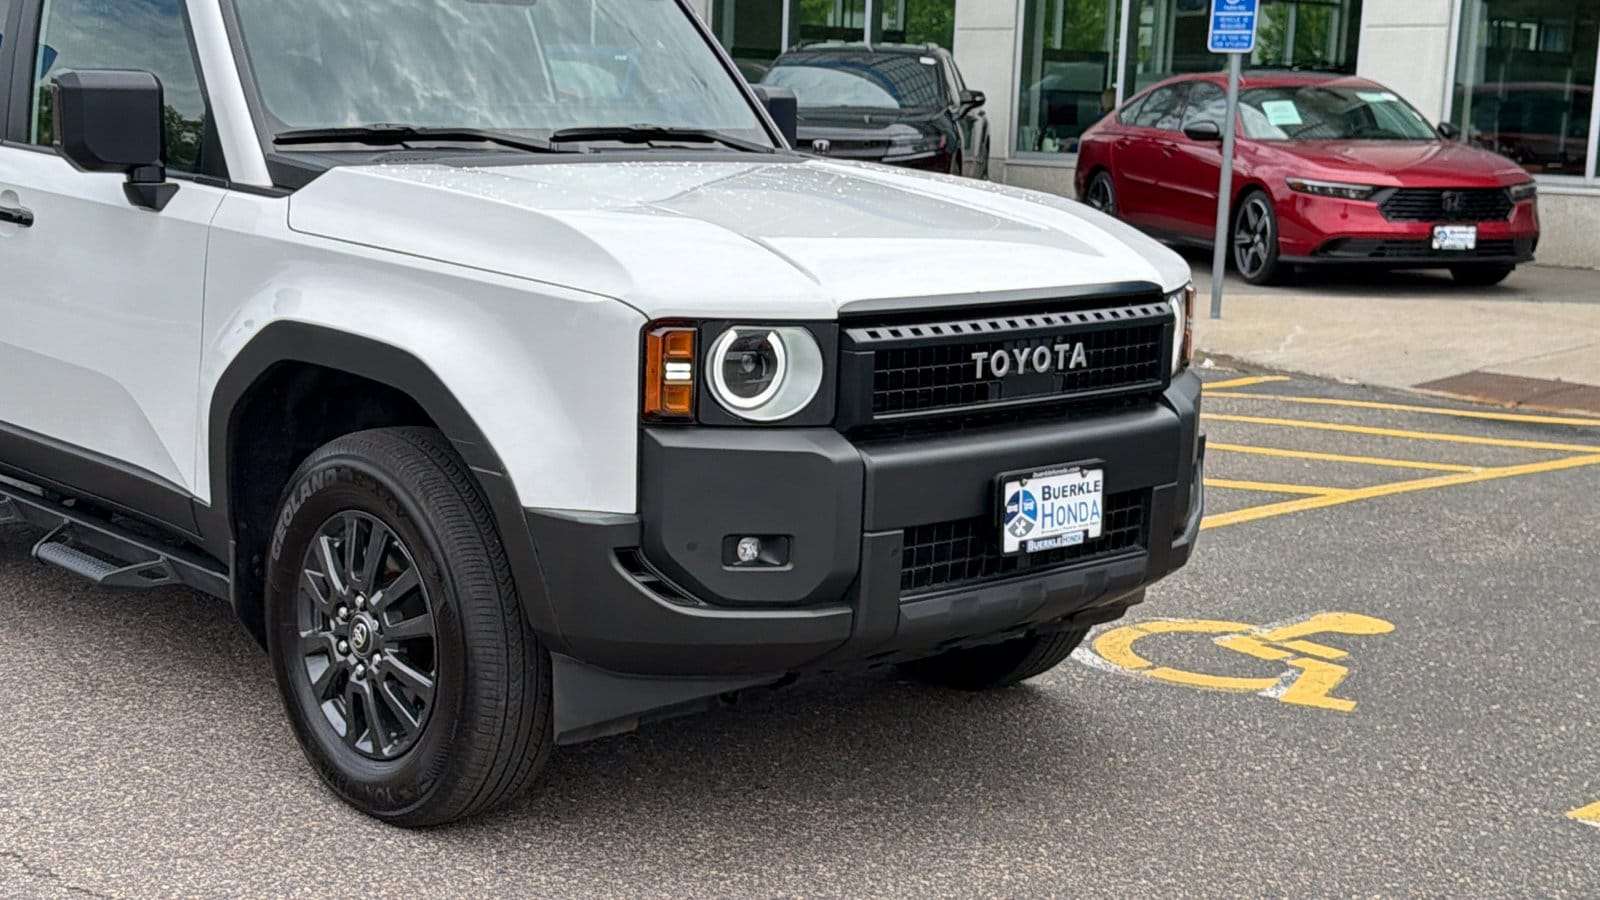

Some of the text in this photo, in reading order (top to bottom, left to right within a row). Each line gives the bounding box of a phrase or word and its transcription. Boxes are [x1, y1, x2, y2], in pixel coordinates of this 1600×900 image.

[971, 342, 1087, 379] TOYOTA
[1041, 480, 1101, 501] BUERKLE
[271, 468, 362, 561] GEOLAND
[1041, 500, 1100, 529] HONDA
